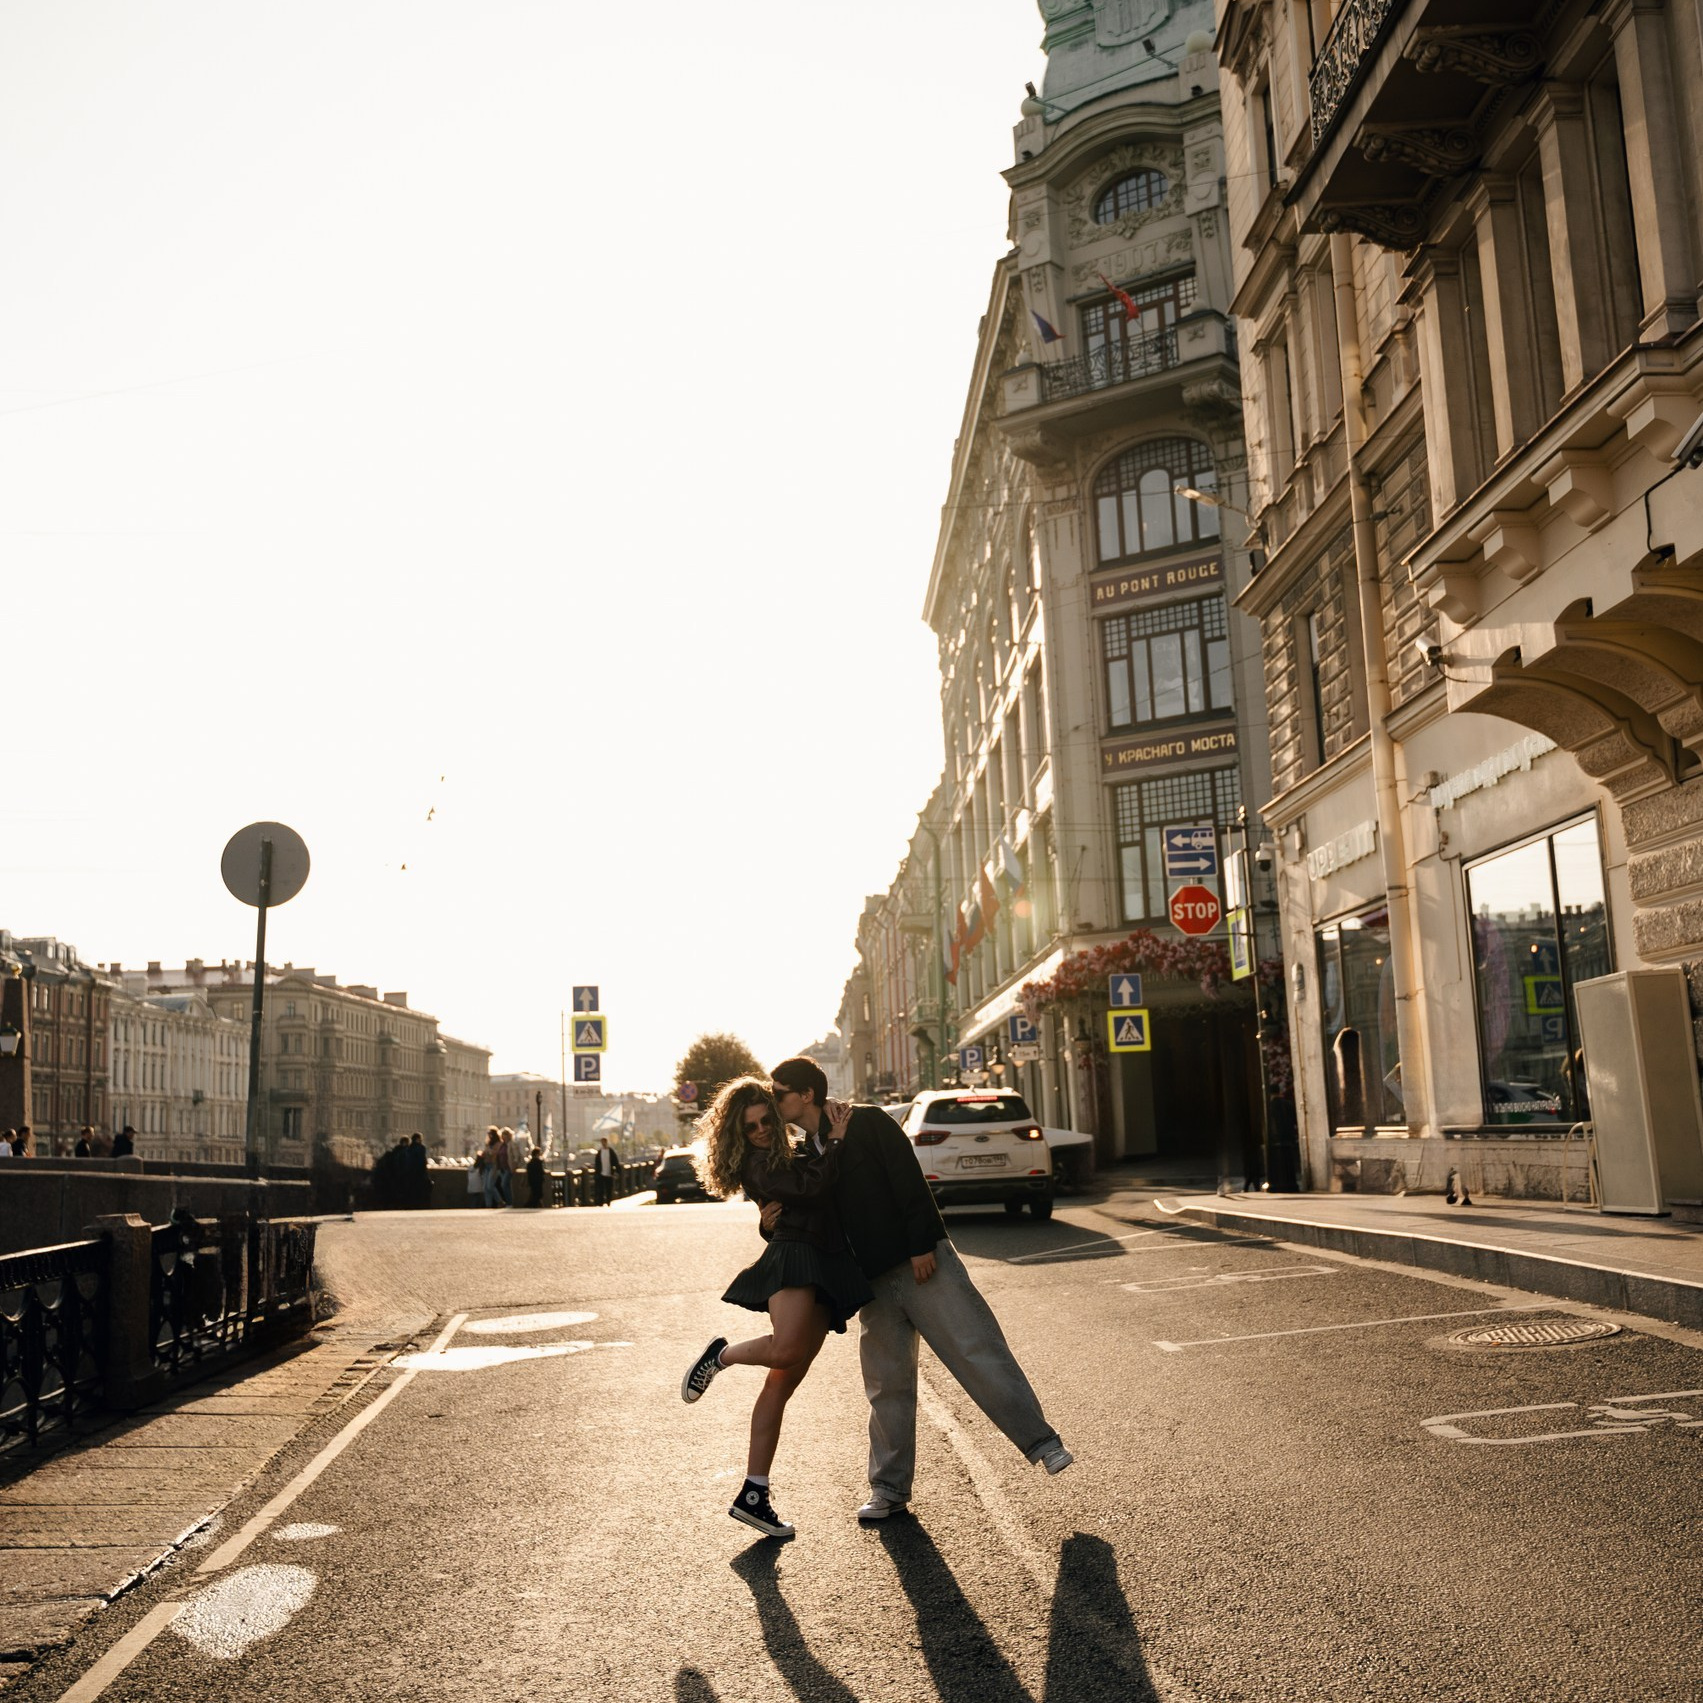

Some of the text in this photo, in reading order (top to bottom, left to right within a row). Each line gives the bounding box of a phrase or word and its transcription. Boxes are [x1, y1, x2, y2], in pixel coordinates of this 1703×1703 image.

[1096, 562, 1219, 600] AU PONT ROUGE
[1105, 733, 1236, 766] У КРАСНАГО МОСТА
[1173, 902, 1217, 920] STOP
[1016, 1017, 1032, 1040] P
[580, 1056, 597, 1080] P
[966, 1049, 979, 1067] P
